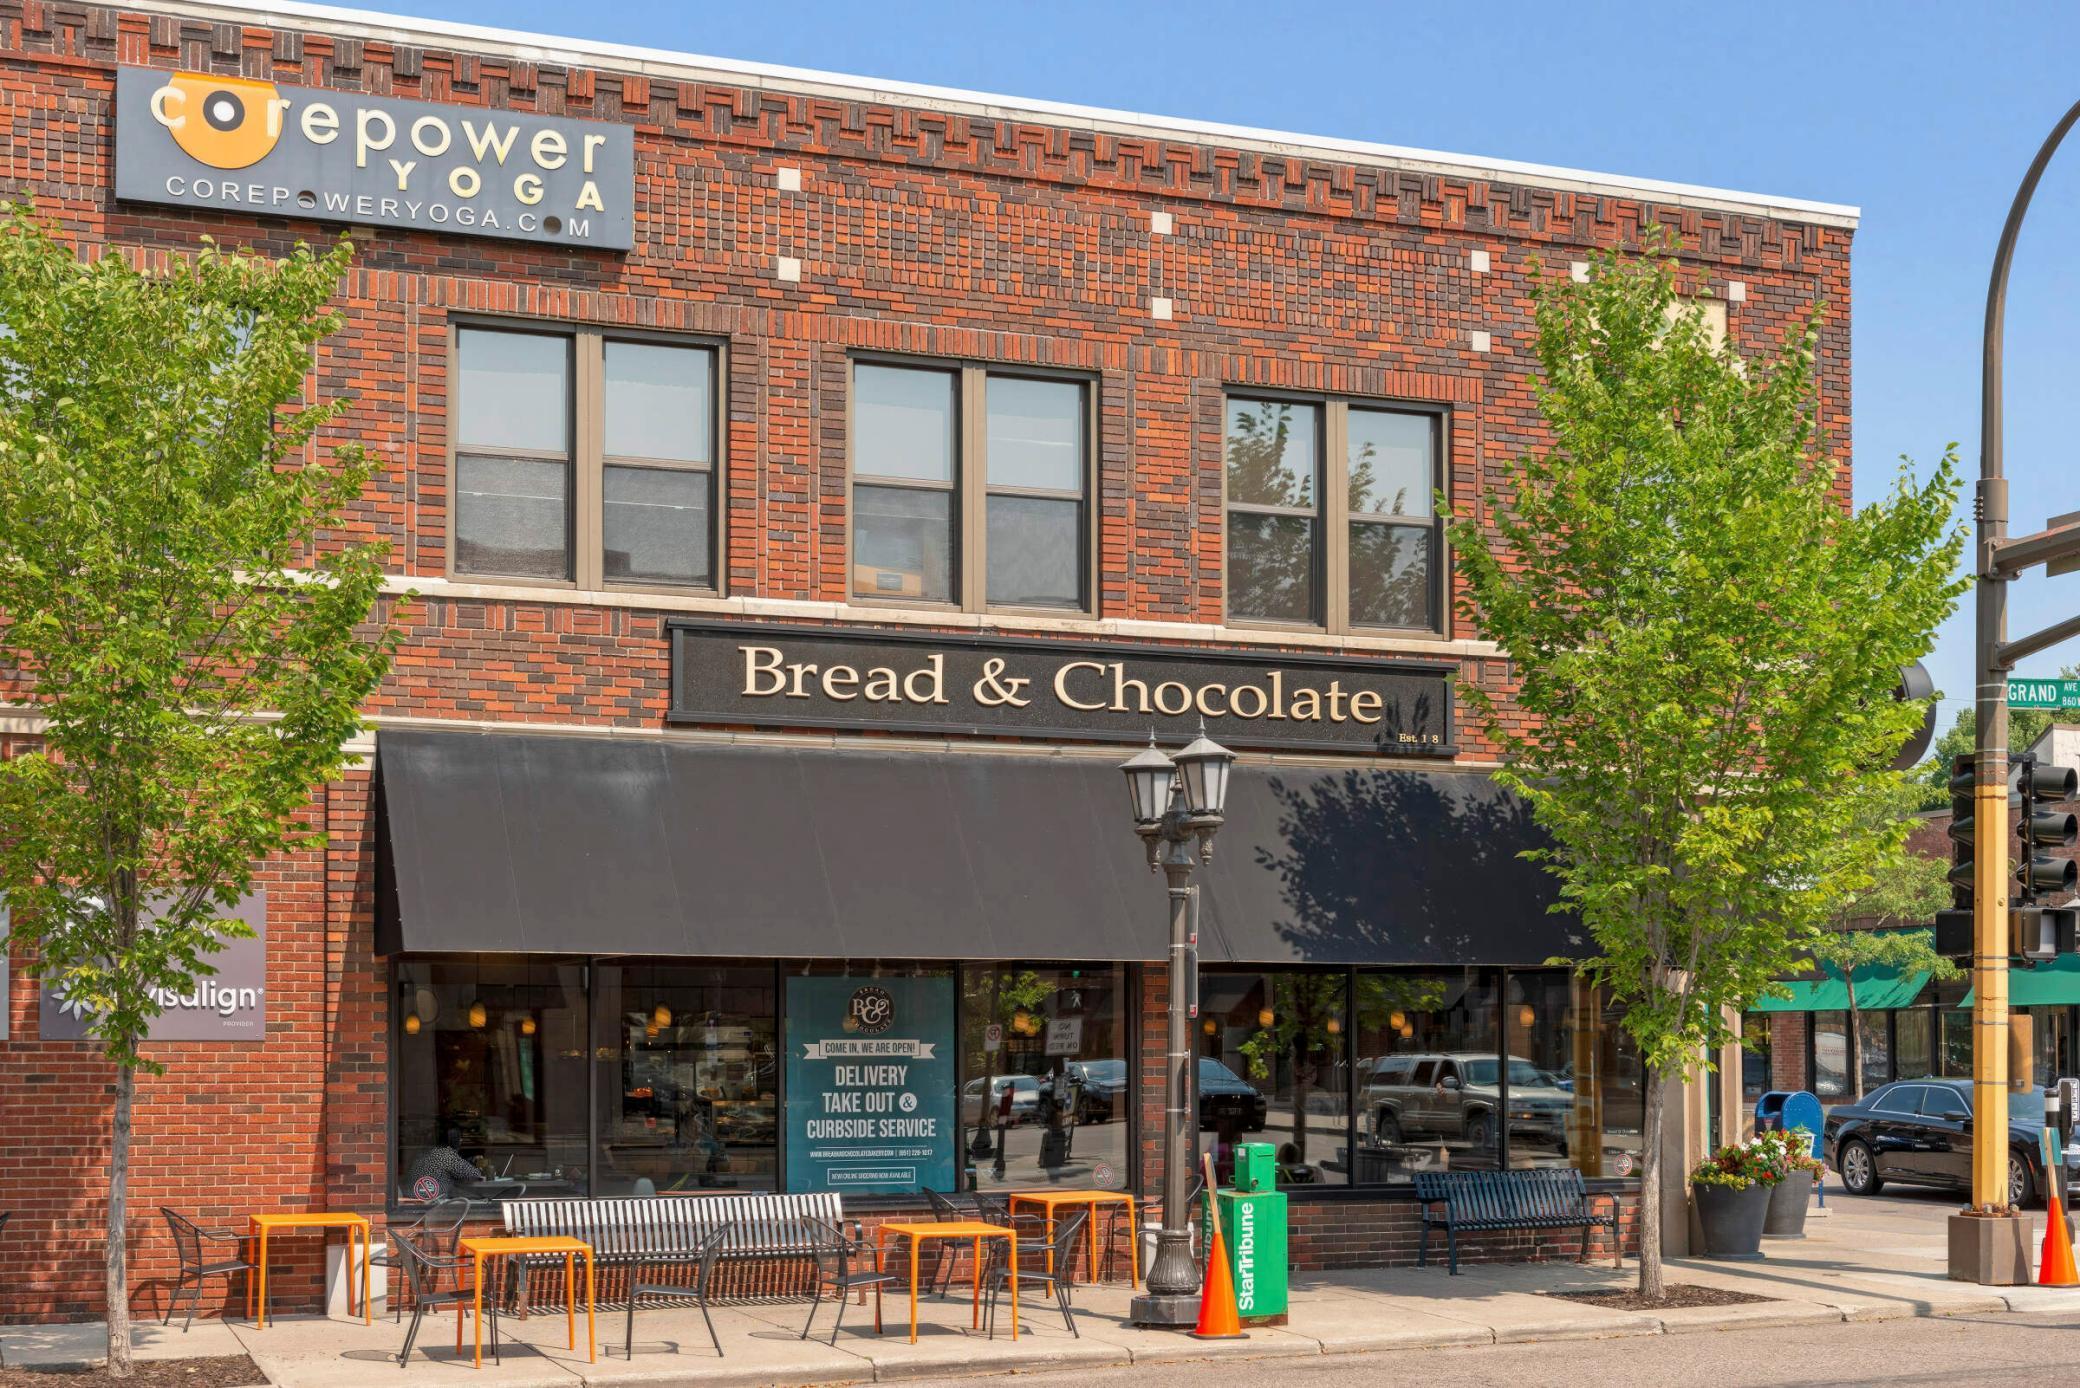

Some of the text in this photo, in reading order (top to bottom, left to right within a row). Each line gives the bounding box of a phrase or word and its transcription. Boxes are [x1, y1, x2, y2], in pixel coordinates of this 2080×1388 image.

[388, 159, 605, 212] YOGA
[738, 645, 1384, 725] Bread & Chocolate
[2008, 682, 2078, 702] GRAND AVE
[825, 1042, 847, 1054] COME
[861, 1042, 874, 1054] WE
[875, 1042, 890, 1053] ARE
[892, 1042, 915, 1053] OPEN!
[835, 1065, 908, 1086] DELIVERY
[822, 1092, 860, 1113] TAKE
[865, 1092, 895, 1112] OUT
[807, 1118, 937, 1138] CURBSIDE SERVICE
[1239, 1202, 1254, 1310] StarTribune
